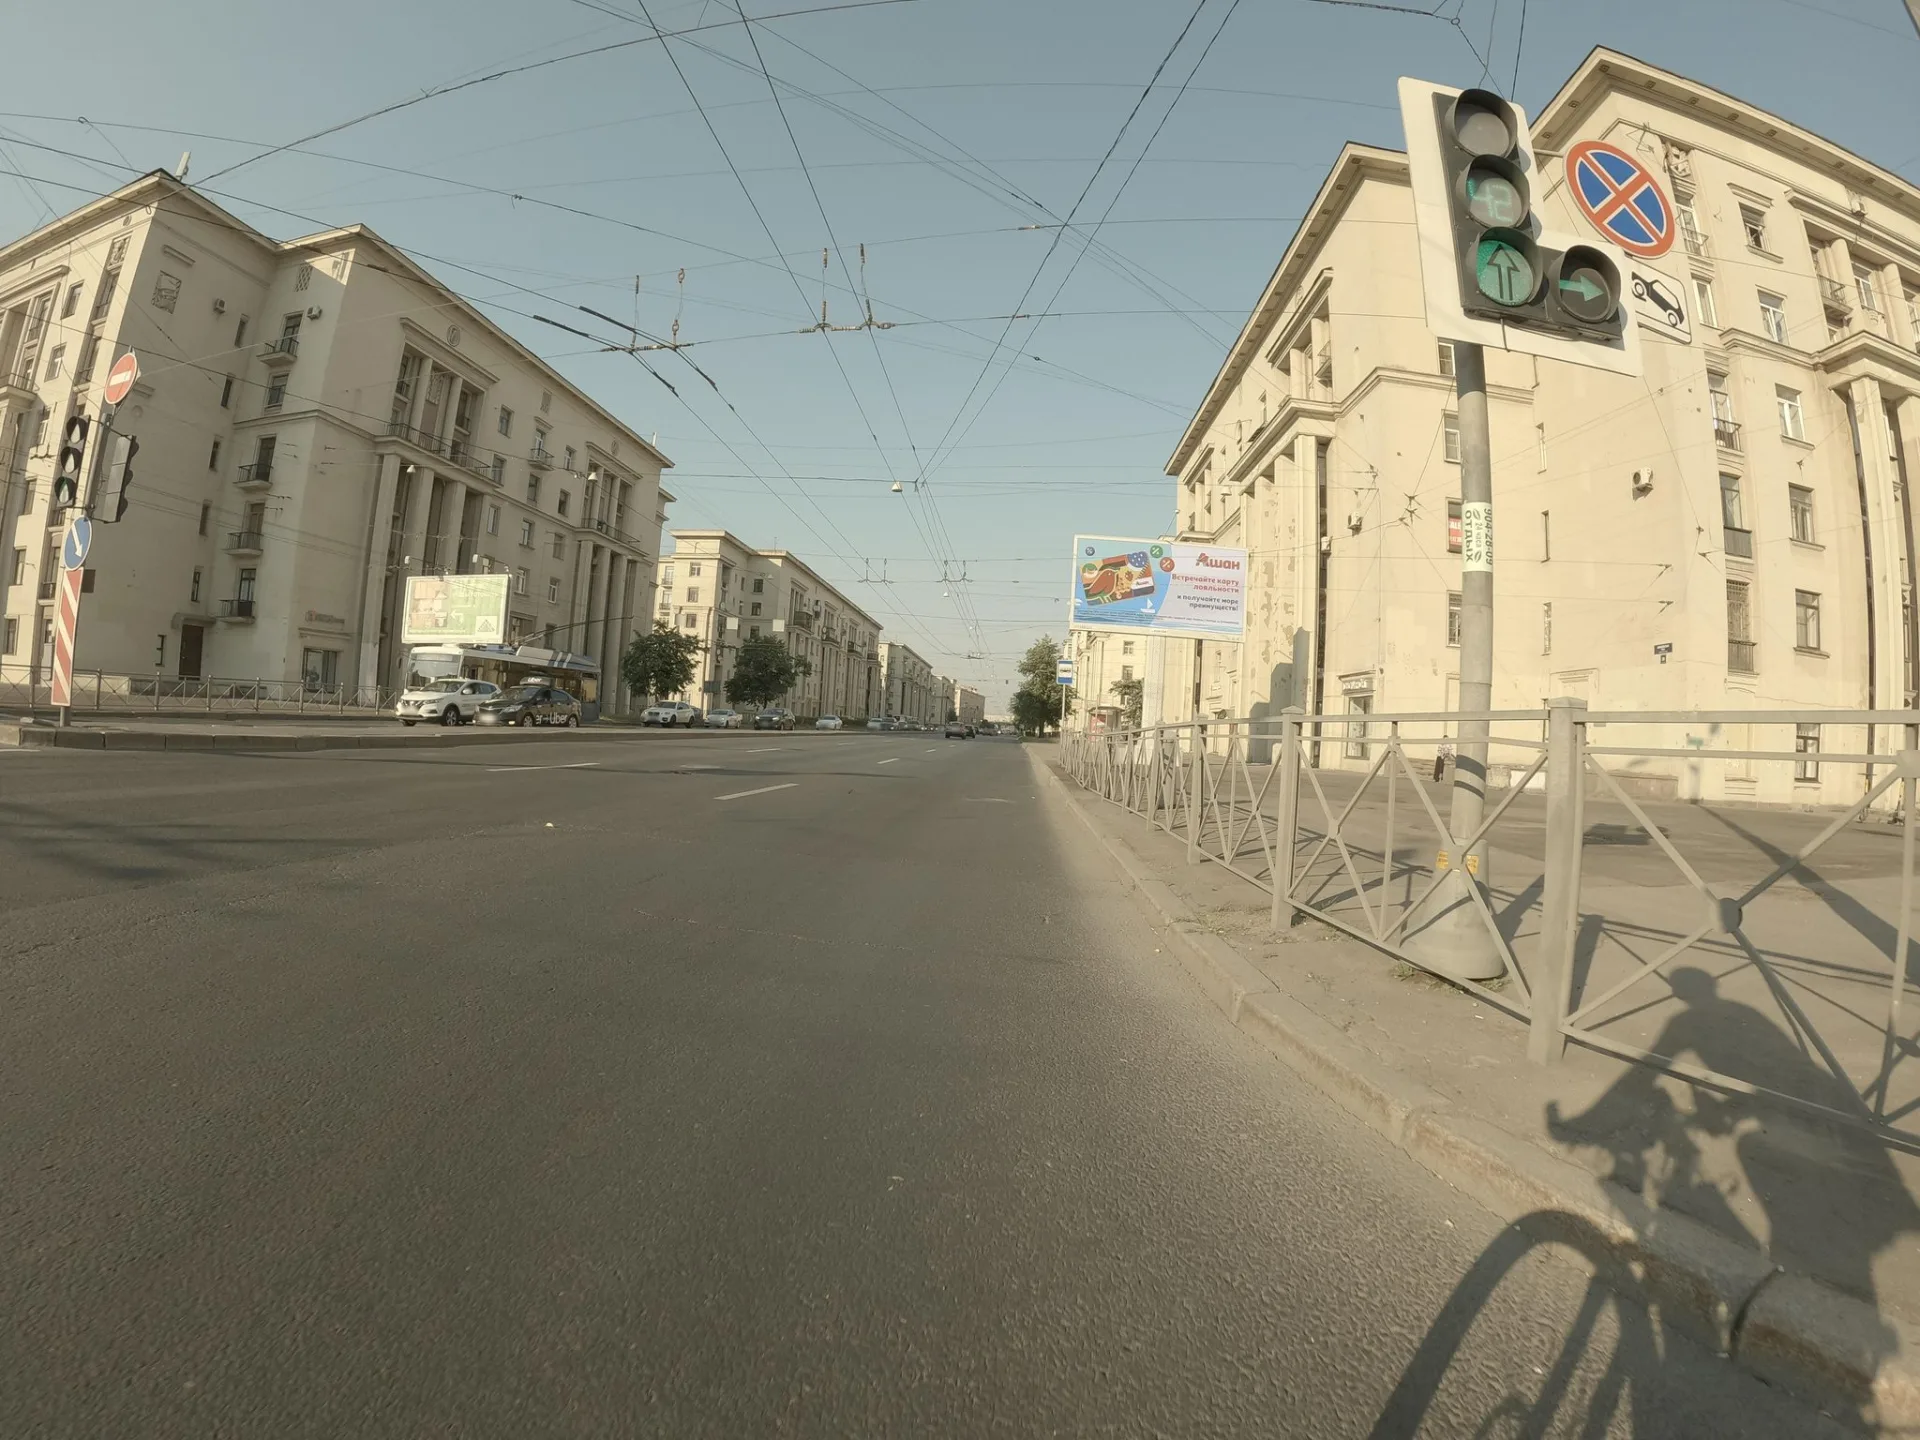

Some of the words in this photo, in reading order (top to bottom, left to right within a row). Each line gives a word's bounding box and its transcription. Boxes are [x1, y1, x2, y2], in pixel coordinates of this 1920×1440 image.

[1196, 552, 1240, 570] Ашан
[1172, 573, 1216, 583] Встречайте
[1217, 578, 1239, 587] карту
[1193, 584, 1239, 593] лояльности
[1183, 595, 1220, 603] получайте
[1189, 602, 1238, 611] преимуществ!
[550, 711, 568, 724] Uber
